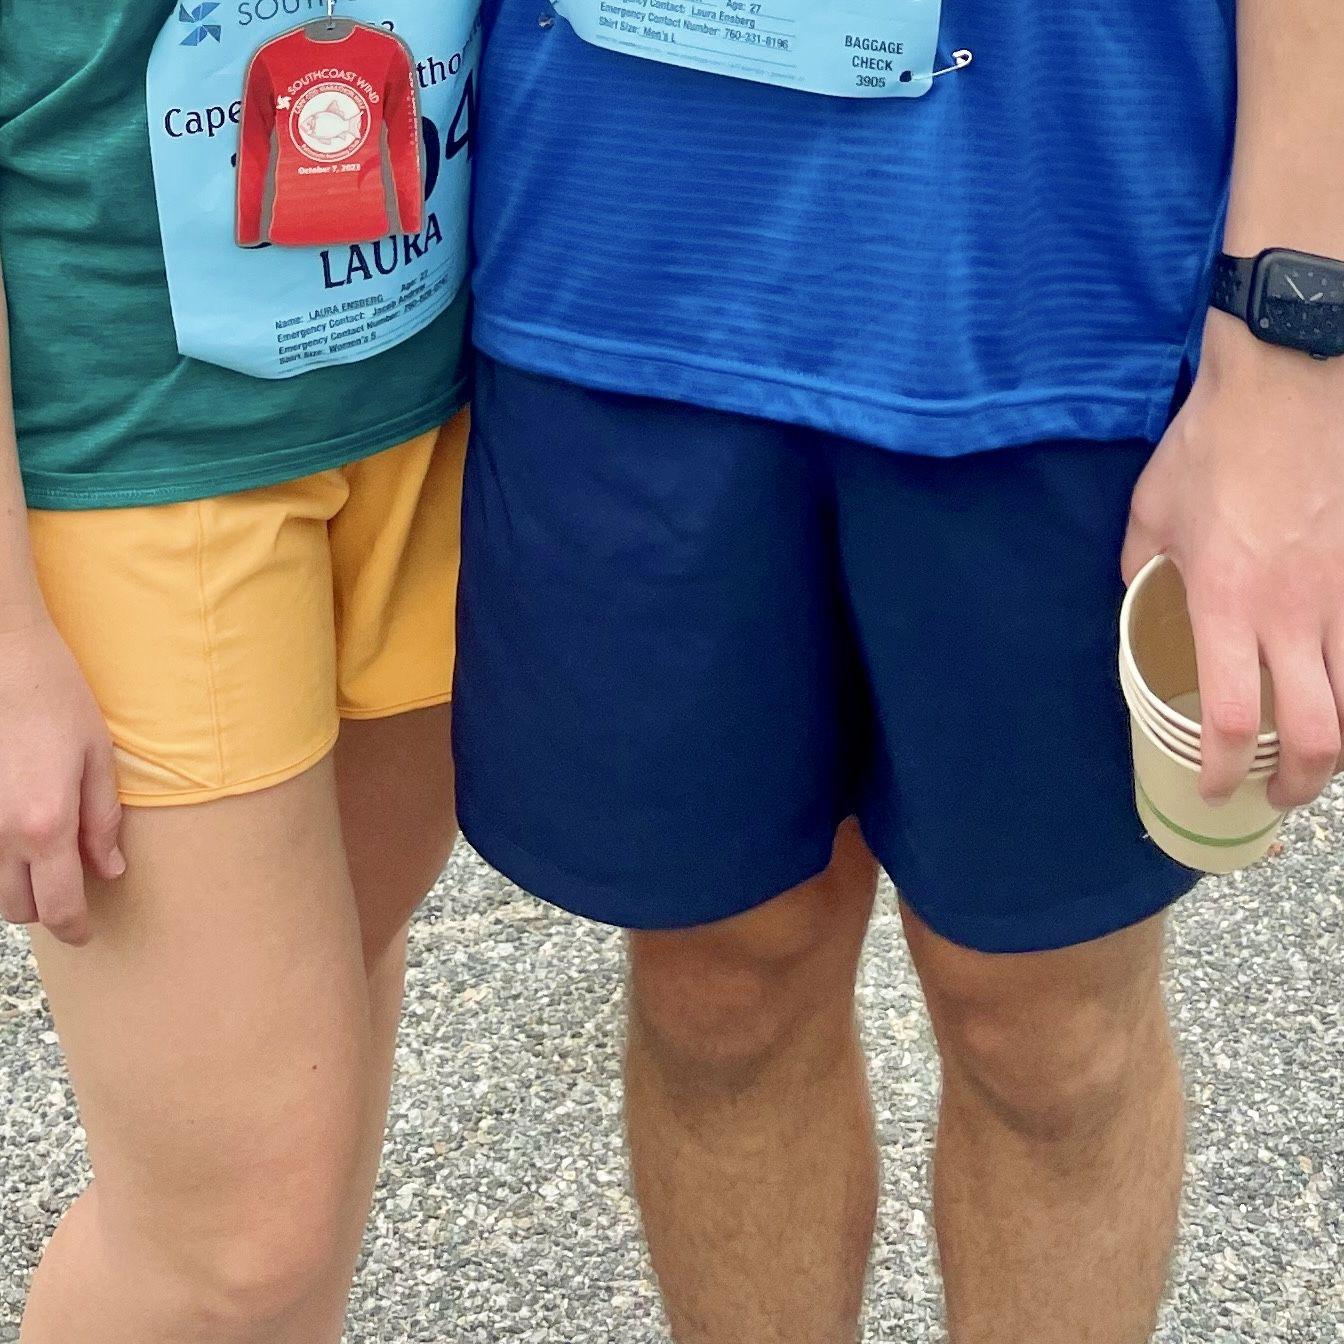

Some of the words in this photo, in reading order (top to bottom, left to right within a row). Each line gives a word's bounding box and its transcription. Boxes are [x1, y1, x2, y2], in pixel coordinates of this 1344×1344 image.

[600, 2, 647, 22] Emergency
[648, 12, 681, 29] Contact
[691, 5, 716, 21] Laura
[844, 35, 904, 55] BAGGAGE
[852, 55, 893, 71] CHECK
[288, 68, 358, 95] SOUTHCOAST
[357, 76, 380, 104] WIND
[856, 74, 886, 88] 3905
[320, 212, 443, 288] LAURA
[309, 305, 338, 320] LAURA
[277, 322, 327, 343] Emergency
[279, 335, 328, 355] Emergency
[330, 327, 365, 341] Contact
[328, 336, 369, 354] Women's
